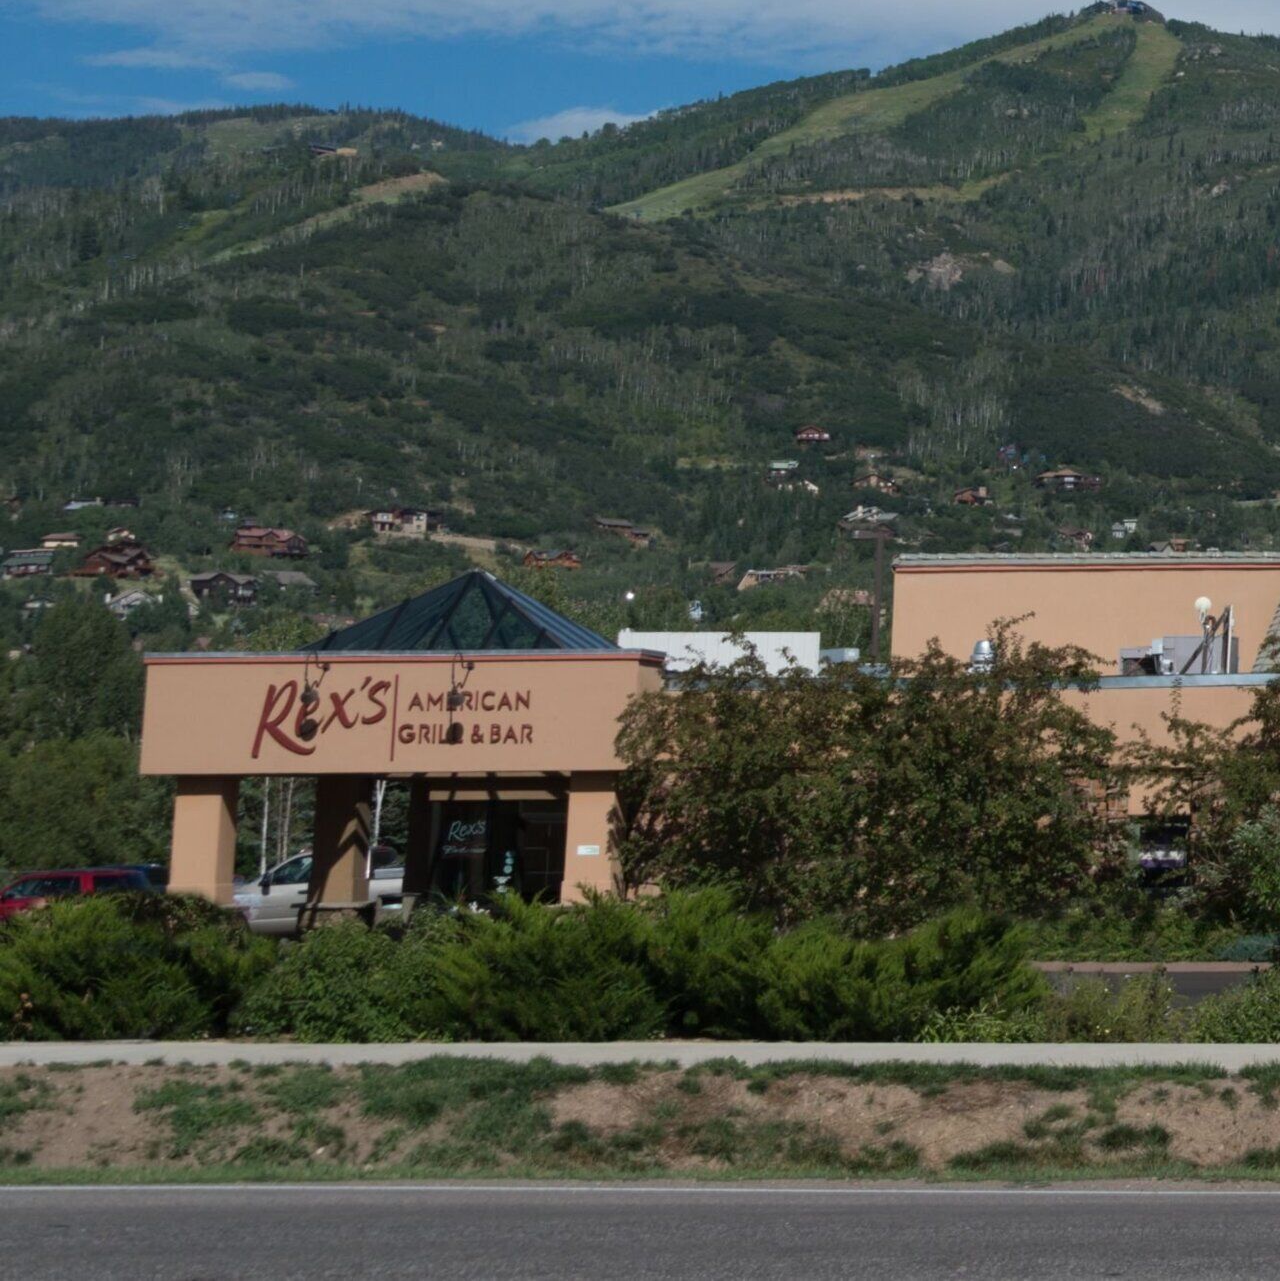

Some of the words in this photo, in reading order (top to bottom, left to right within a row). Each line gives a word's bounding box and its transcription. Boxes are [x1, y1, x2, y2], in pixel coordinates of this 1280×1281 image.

[398, 723, 464, 745] GRIL
[470, 723, 484, 745] &
[489, 723, 533, 745] BAR
